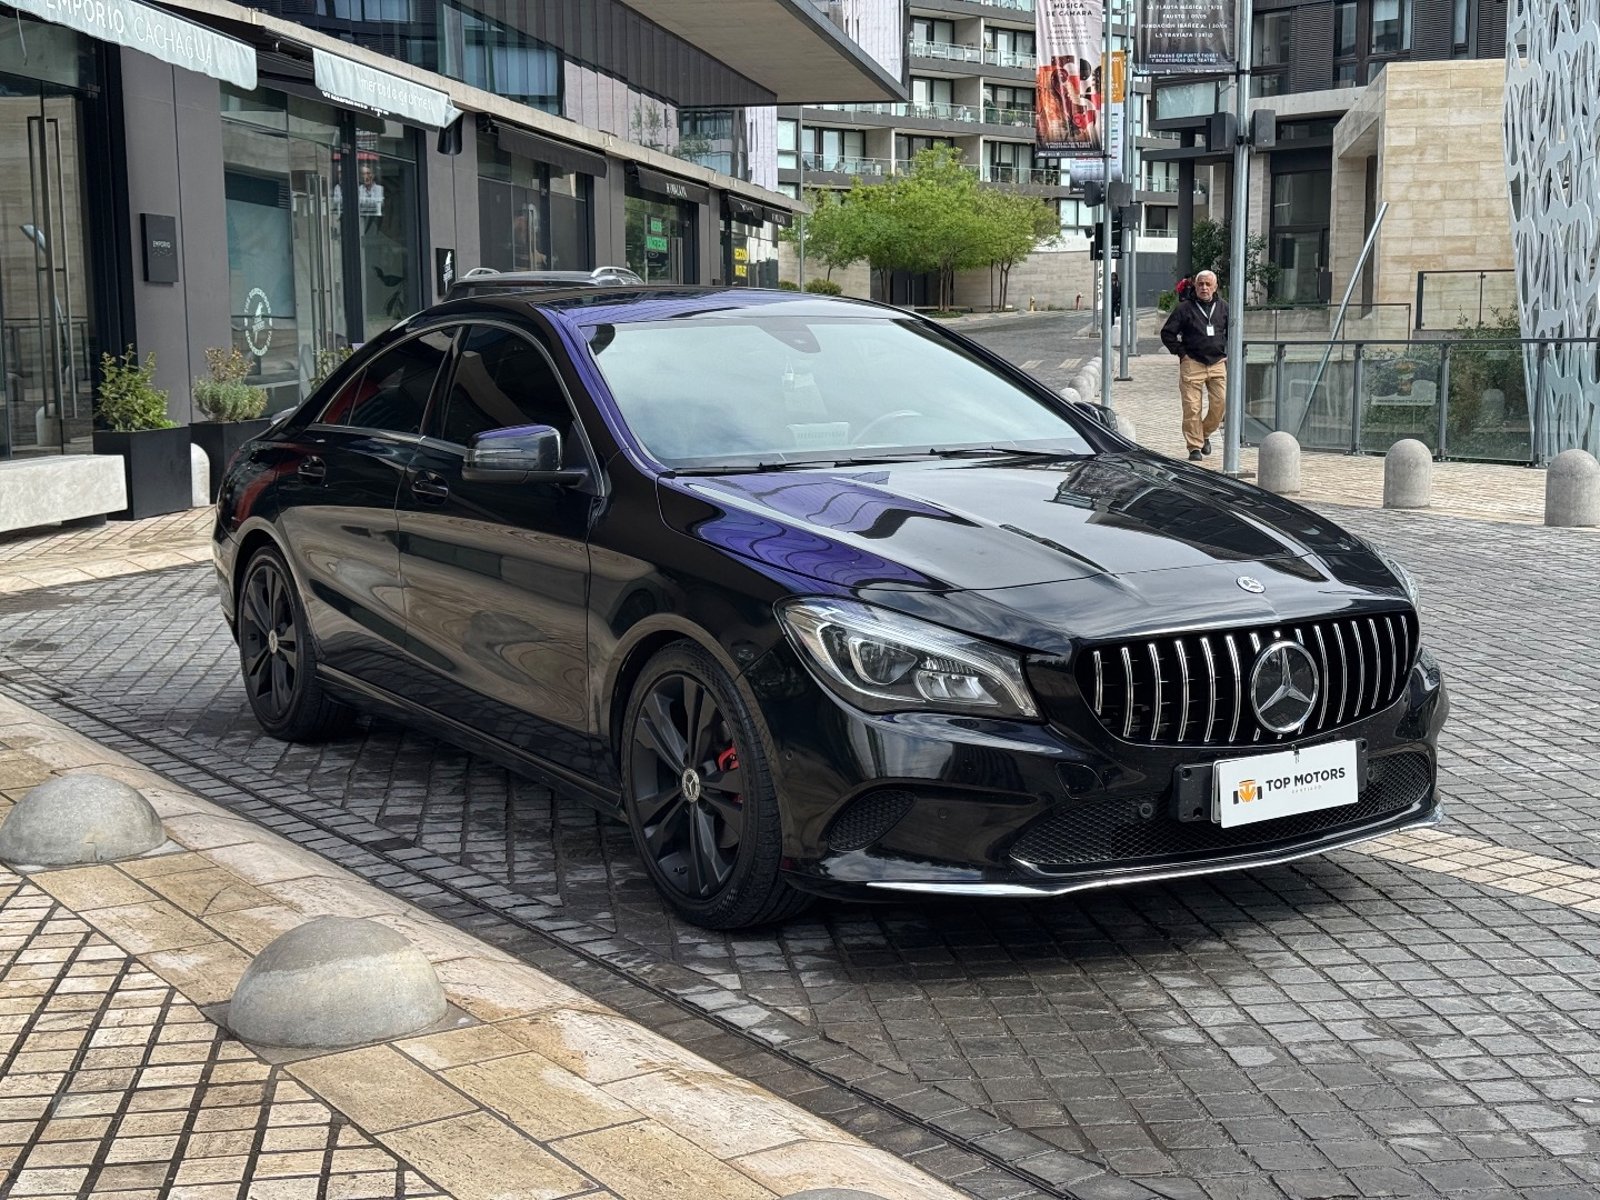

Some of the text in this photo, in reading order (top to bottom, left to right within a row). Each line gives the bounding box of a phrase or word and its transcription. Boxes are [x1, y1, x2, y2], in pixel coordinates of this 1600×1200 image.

[134, 18, 212, 66] CACHAGUA
[1265, 767, 1346, 792] TOP MOTORS
